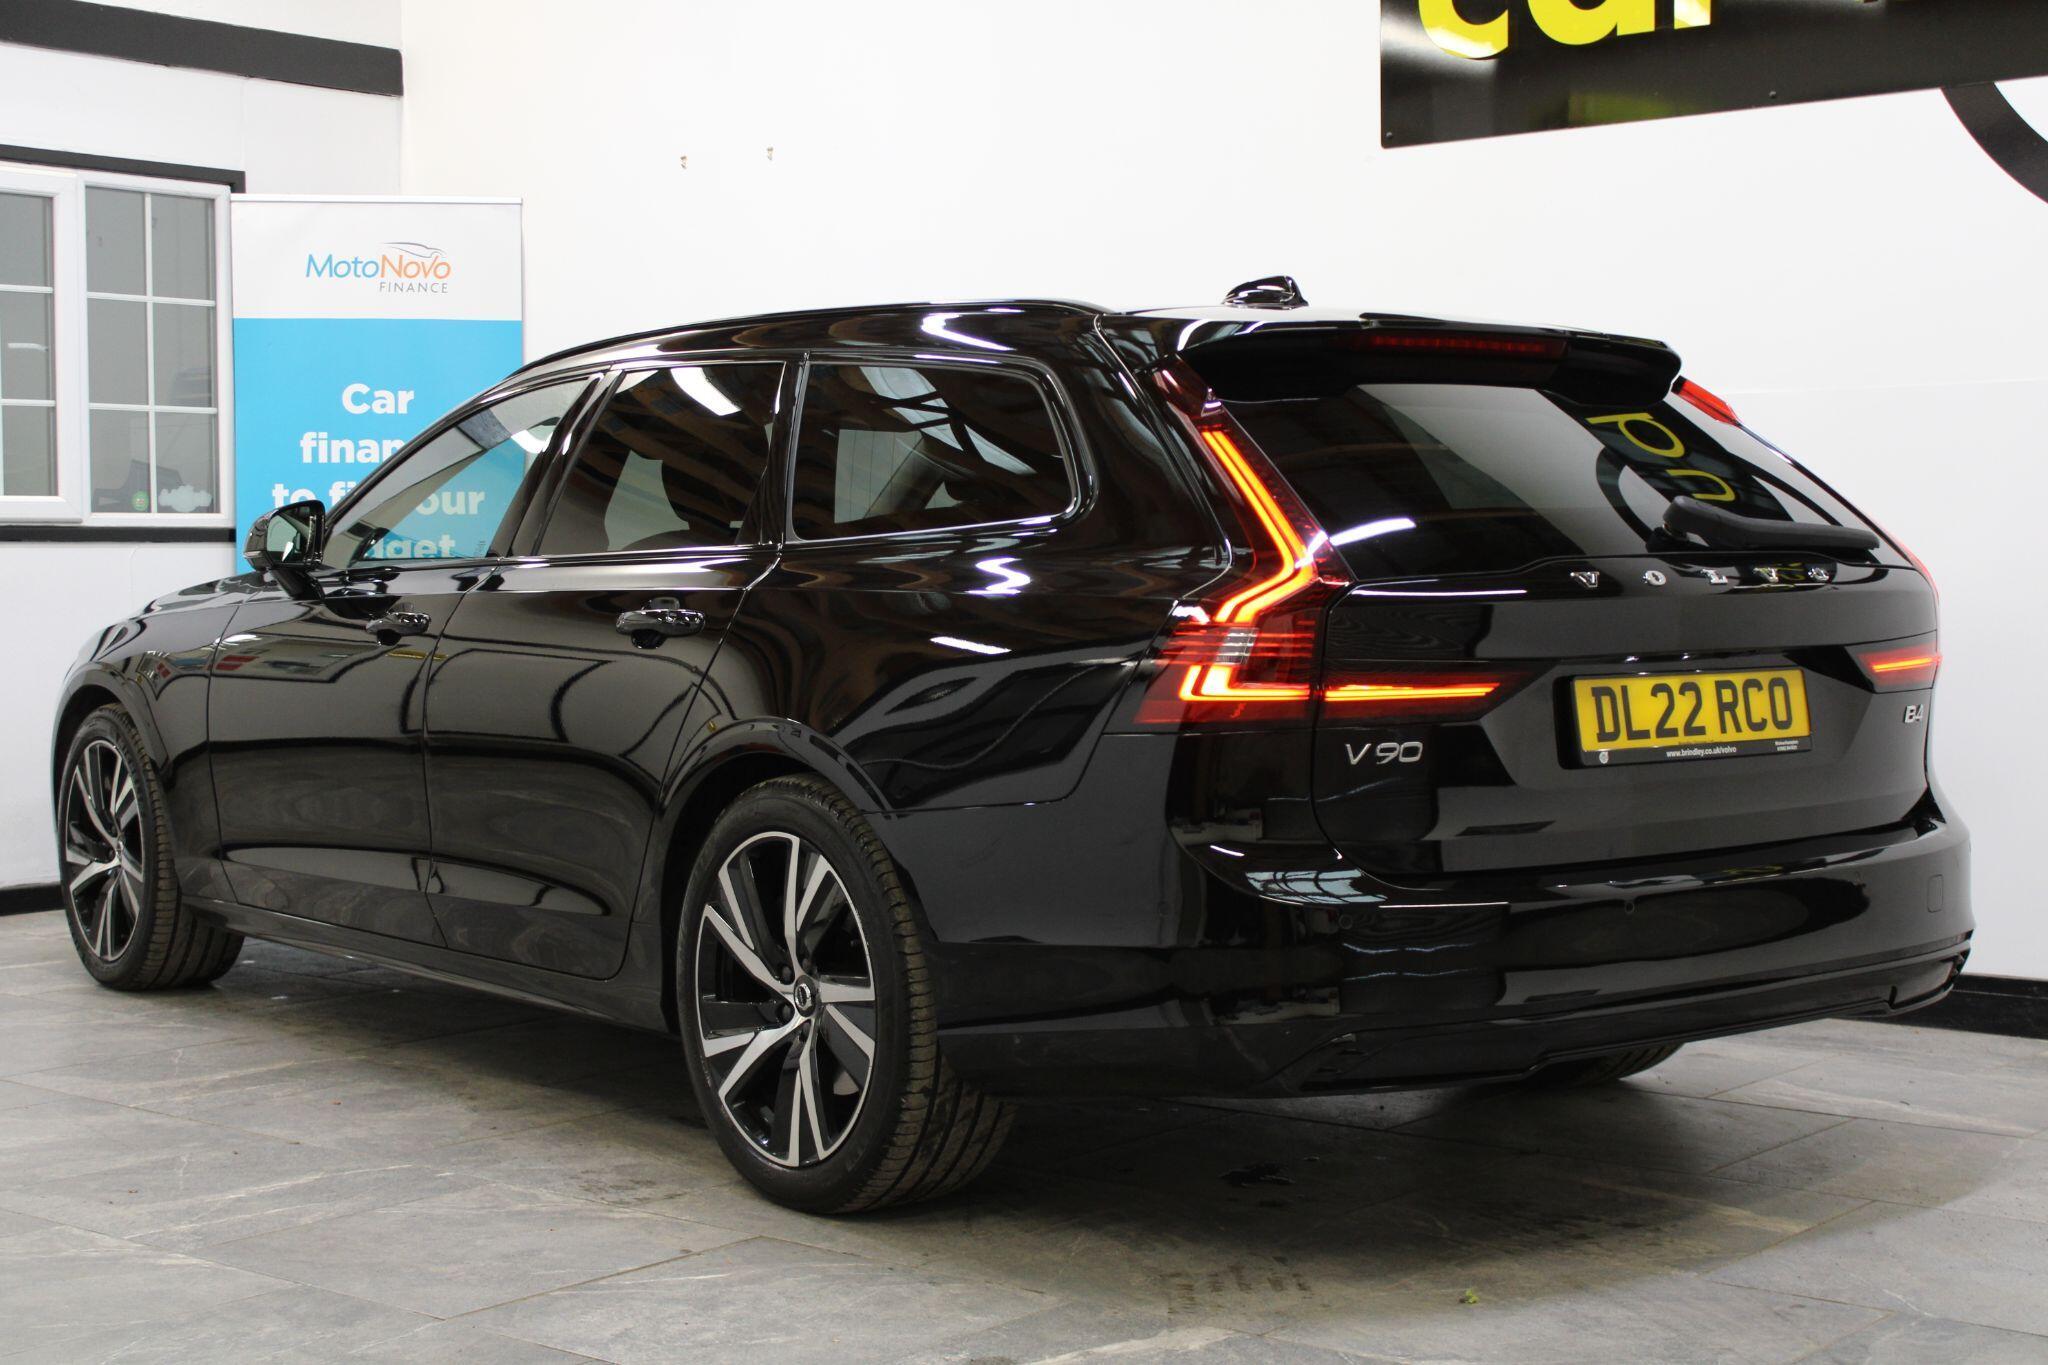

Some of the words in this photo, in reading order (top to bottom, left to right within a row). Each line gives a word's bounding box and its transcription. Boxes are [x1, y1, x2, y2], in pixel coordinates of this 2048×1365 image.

[306, 253, 452, 280] MotoNovo
[379, 281, 449, 294] FINANCE
[341, 383, 415, 415] Car
[1570, 567, 1830, 588] VOLVO
[1590, 681, 1707, 743] DL22
[1714, 677, 1793, 735] RCO
[1903, 703, 1924, 724] B4
[1666, 745, 1738, 758] www.brindley.co.uk/volvo
